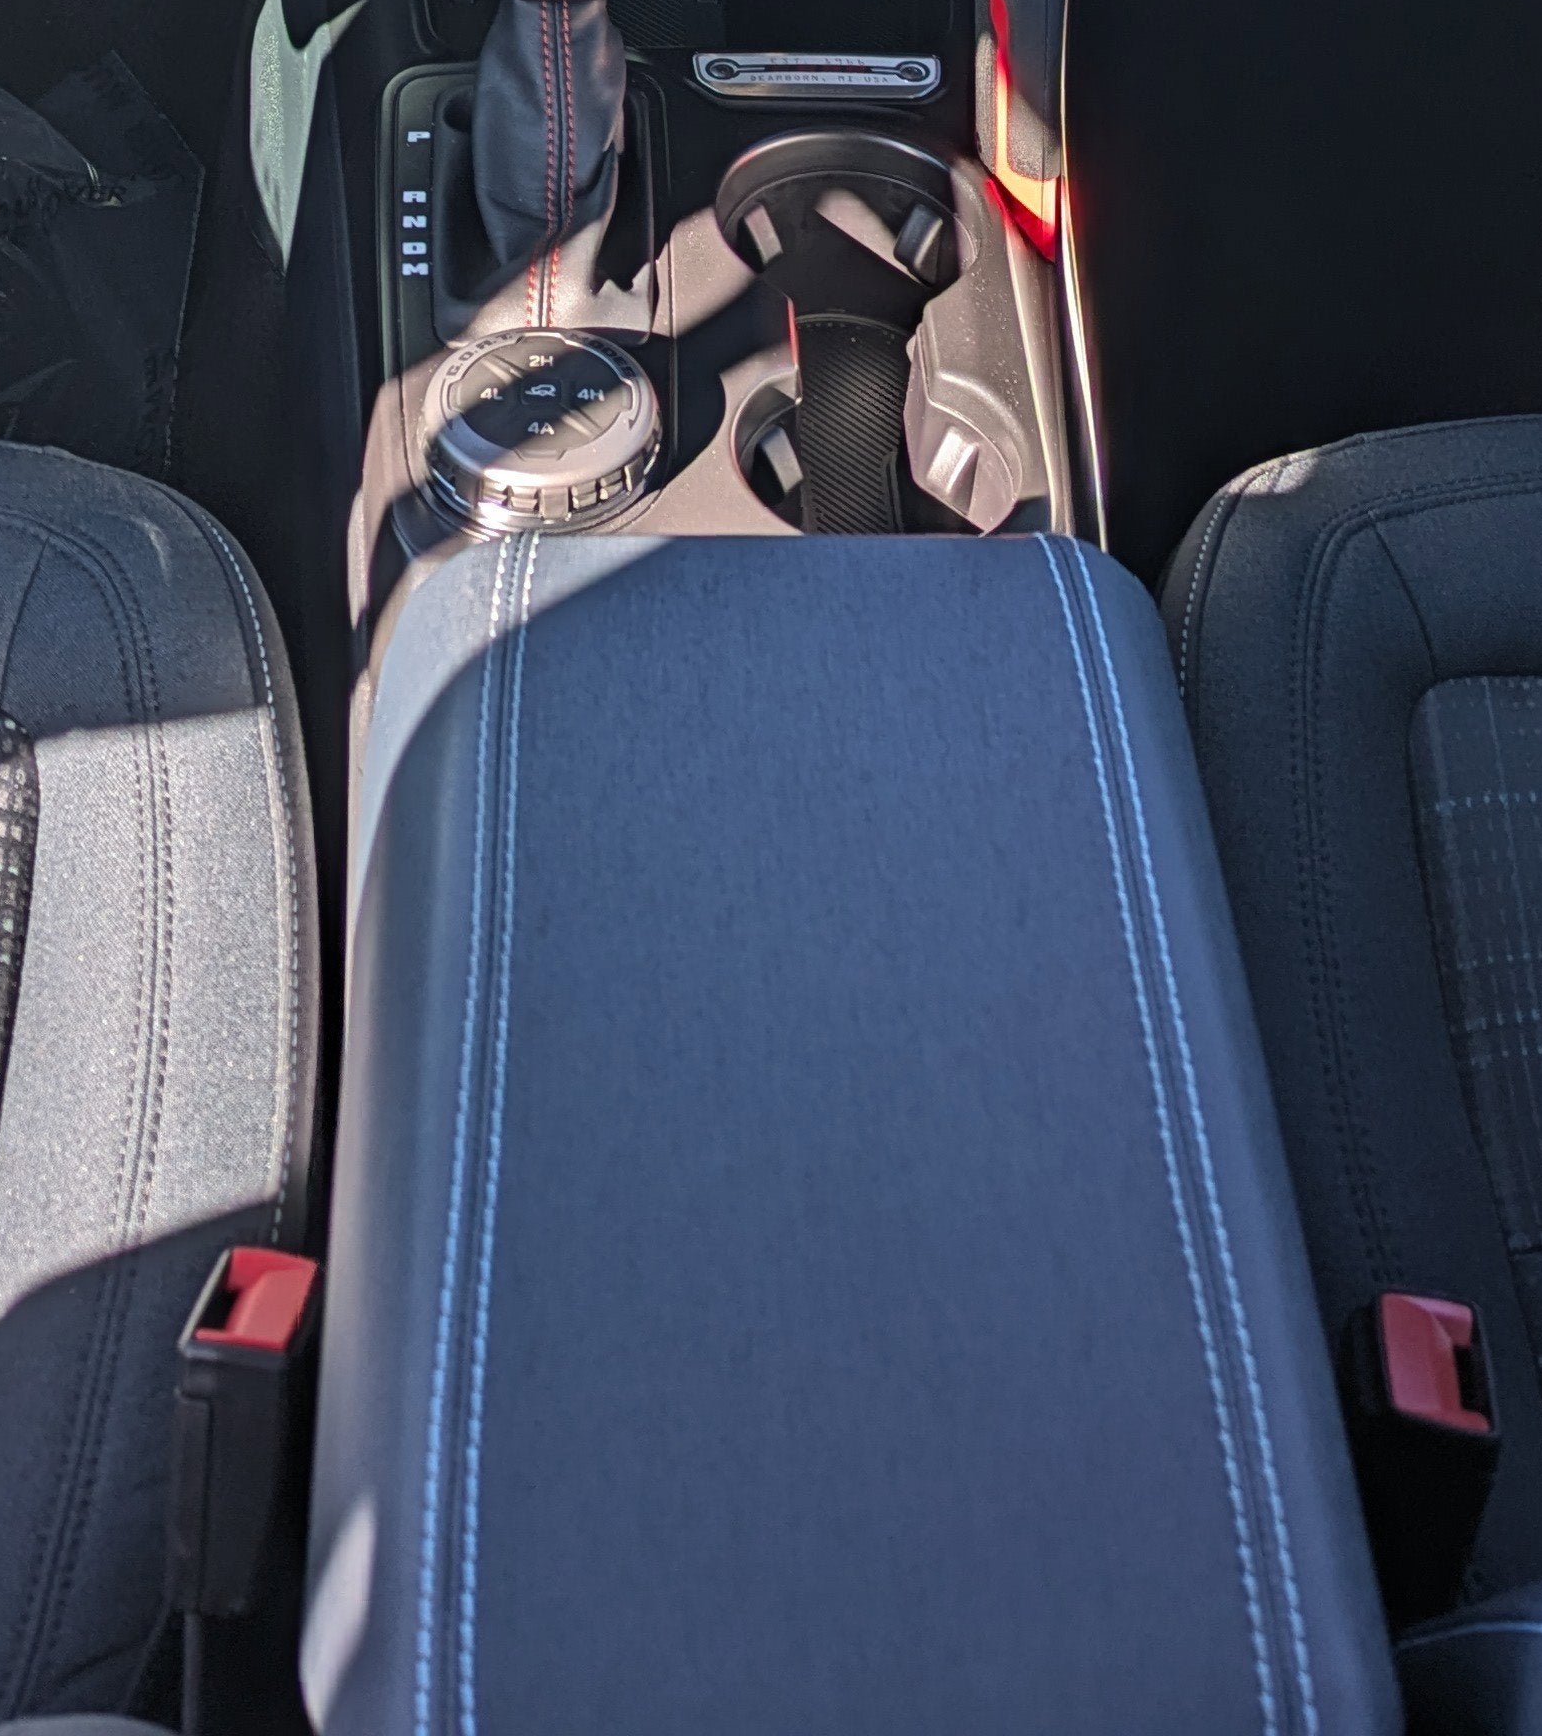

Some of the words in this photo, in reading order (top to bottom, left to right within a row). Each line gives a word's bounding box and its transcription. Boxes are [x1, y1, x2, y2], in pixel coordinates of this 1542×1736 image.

[863, 76, 889, 84] USA
[408, 131, 431, 143] P
[402, 190, 427, 203] R
[402, 215, 427, 228] N
[402, 241, 427, 255] D
[402, 263, 429, 276] M
[529, 356, 554, 368] 2H
[480, 388, 503, 401] 4L
[577, 388, 605, 401] 4H
[528, 422, 555, 436] 4A
